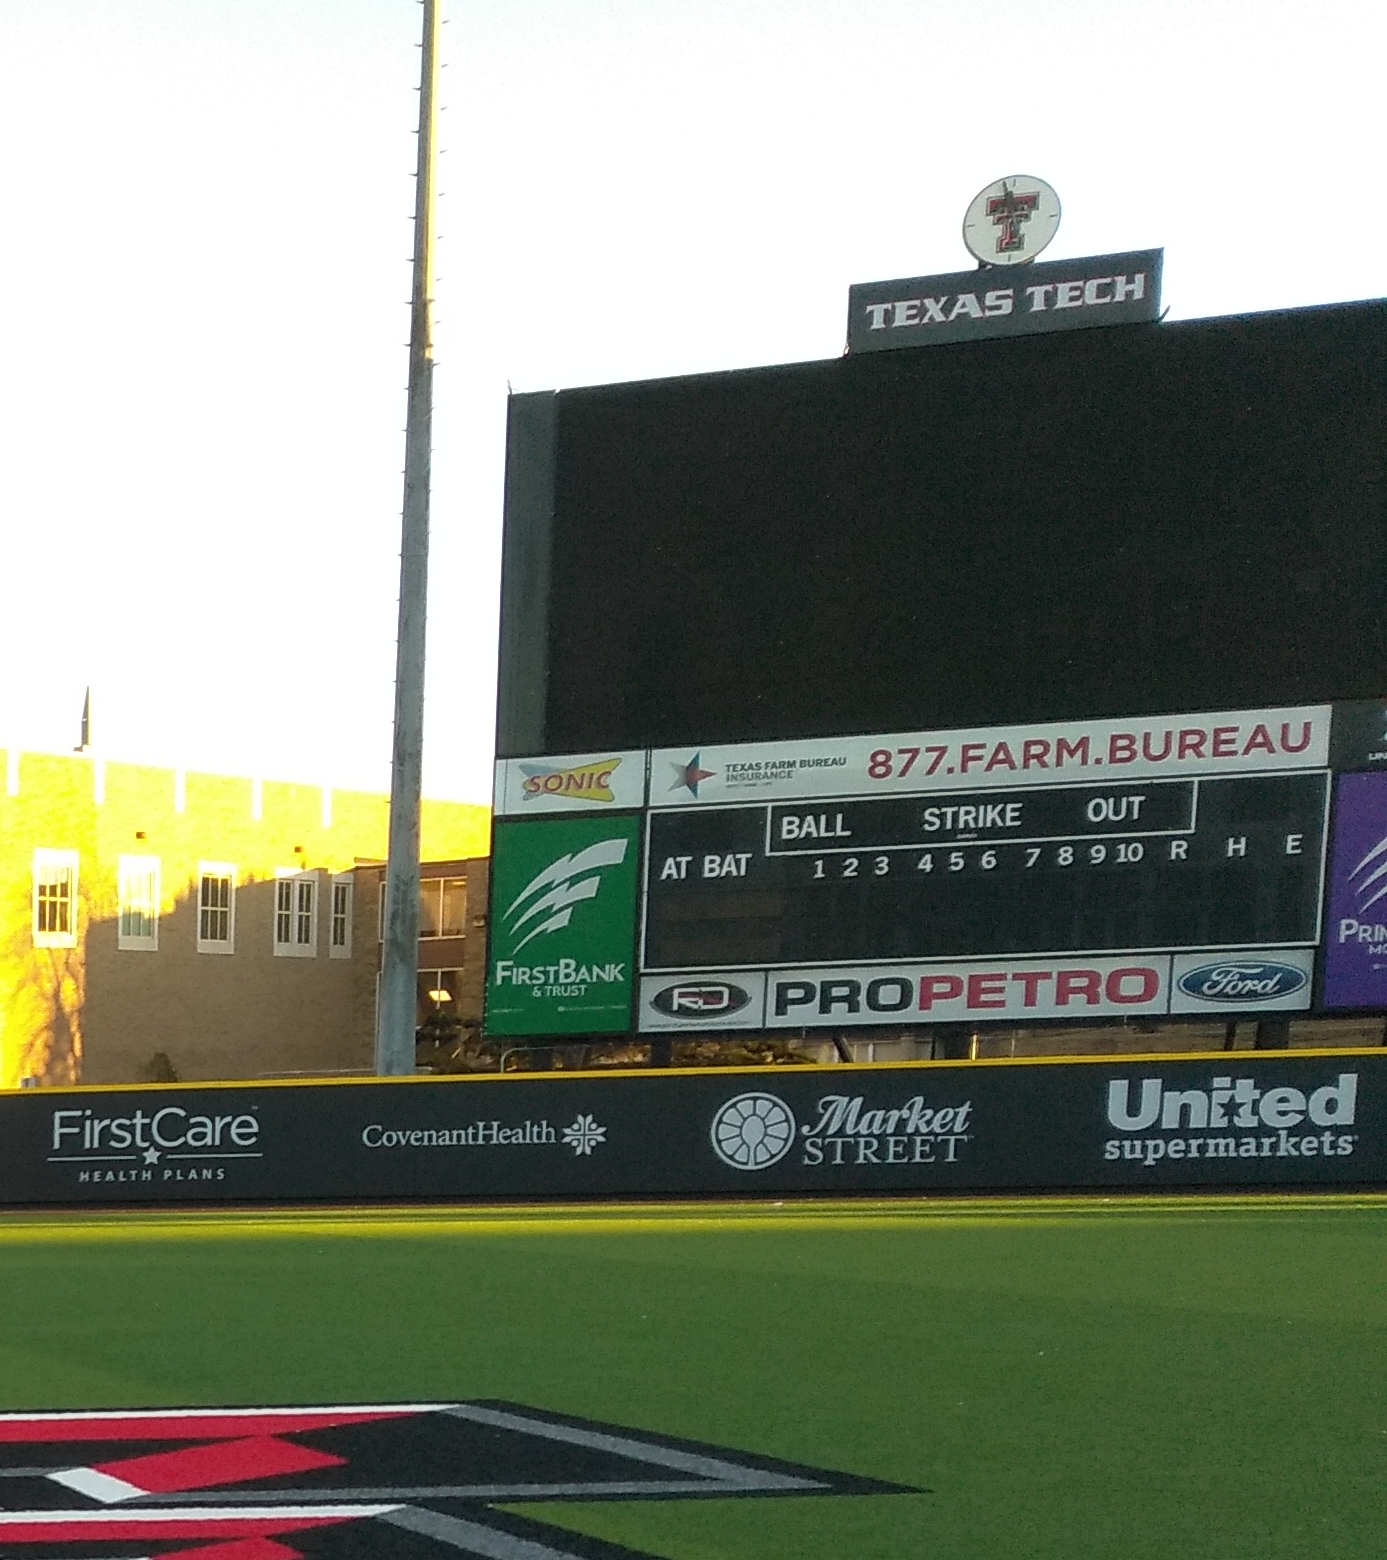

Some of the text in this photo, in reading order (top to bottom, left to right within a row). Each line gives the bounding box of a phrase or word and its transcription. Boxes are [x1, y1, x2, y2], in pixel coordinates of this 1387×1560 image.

[865, 273, 1145, 330] TEXAS TECH
[725, 757, 847, 773] TEXAS FARM BUREAU
[868, 721, 1312, 779] 877.FARM.BUREAU
[527, 770, 612, 793] SONIC
[726, 770, 794, 782] INSURANCE
[781, 796, 1146, 840] BALL STRIKE OUT
[660, 853, 752, 881] AT BAT
[813, 834, 1303, 879] 1 2 3 4 5 6 7 8 9 10 R H E
[496, 958, 625, 985] FIRSTBANK
[1203, 966, 1282, 995] Ford
[532, 984, 587, 997] & TRUST
[774, 967, 1159, 1017] PROPETRO
[801, 1095, 973, 1136] Market
[1108, 1073, 1358, 1131] United
[53, 1107, 259, 1150] FirstCare
[362, 1121, 556, 1147] CovenantHealth
[804, 1135, 968, 1165] STREET
[1104, 1130, 1354, 1166] supermarkets
[79, 1168, 225, 1183] HEALTH PLANS
